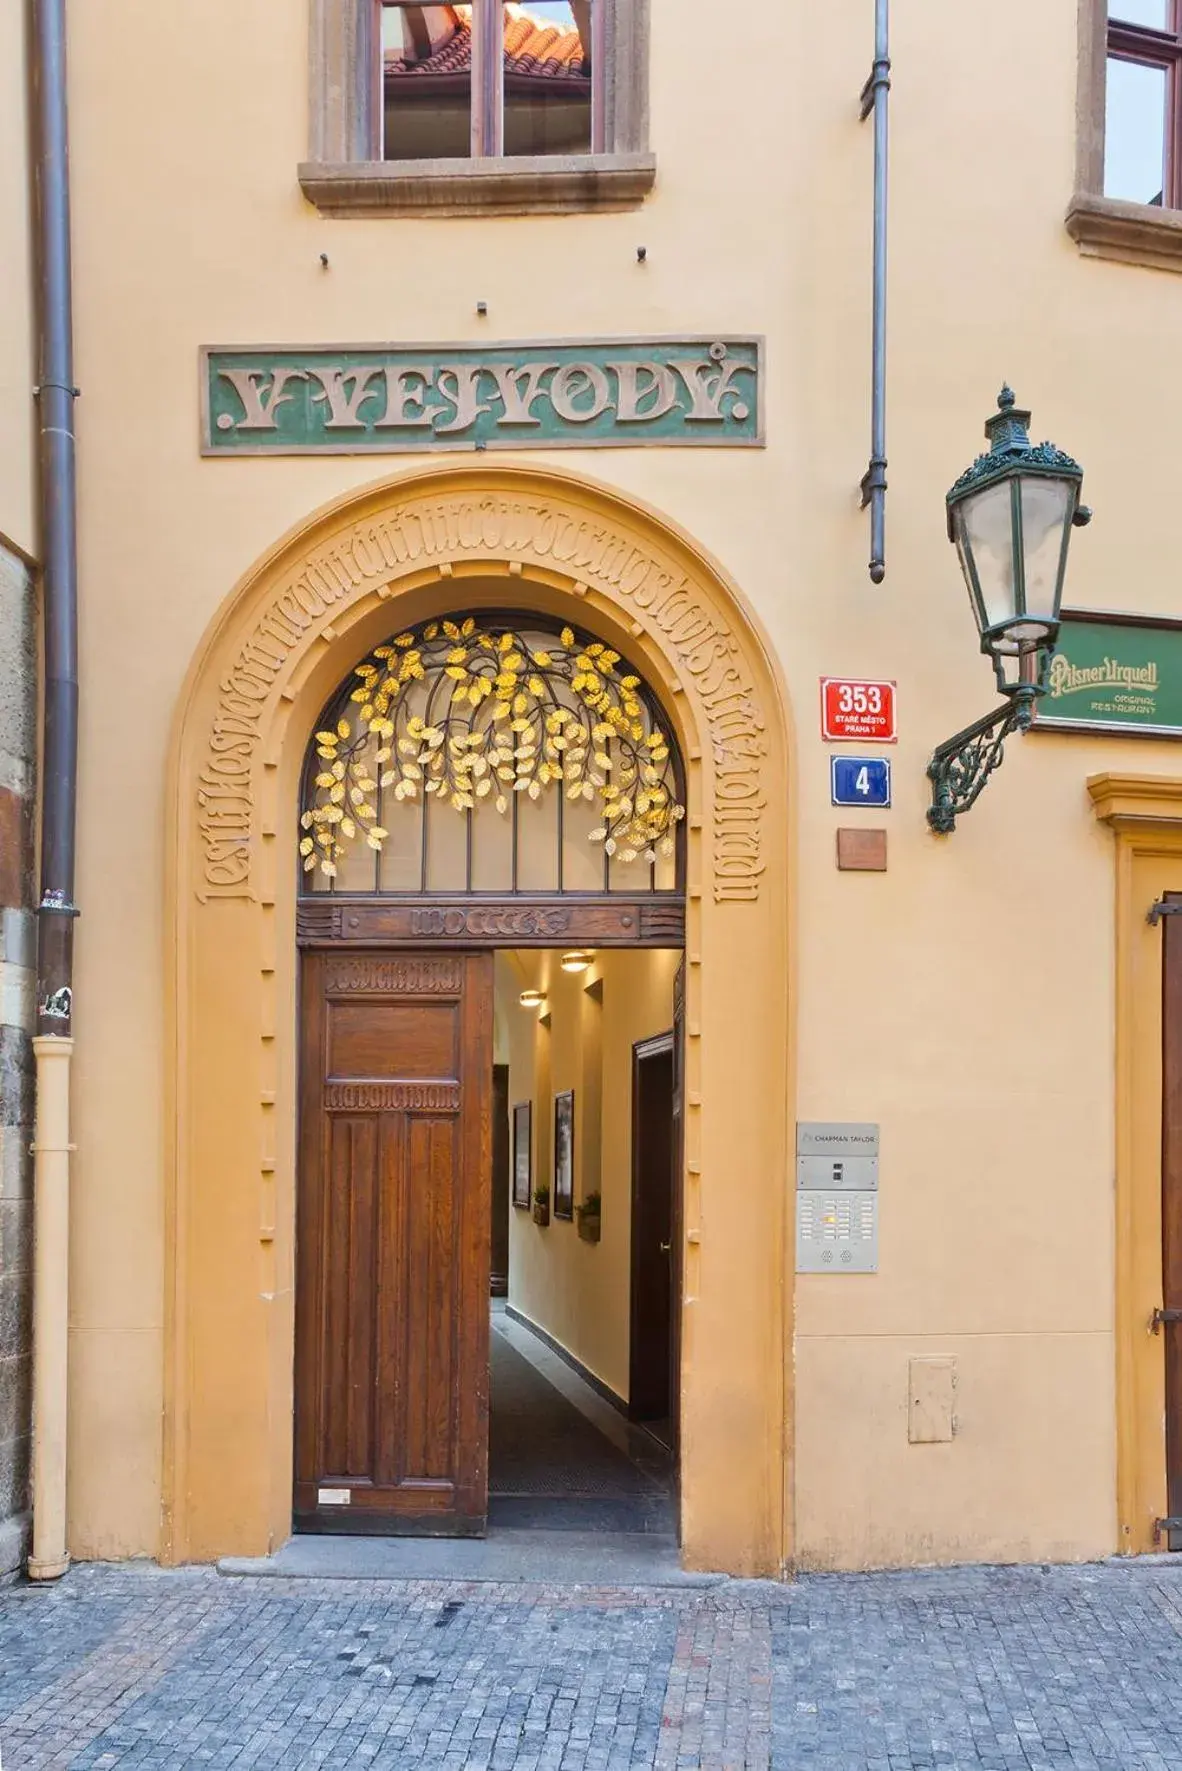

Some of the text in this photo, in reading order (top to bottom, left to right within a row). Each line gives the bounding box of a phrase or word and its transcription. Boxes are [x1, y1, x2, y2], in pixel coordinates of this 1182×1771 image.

[1050, 654, 1158, 698] Pilsner Urquell
[839, 685, 881, 713] 353
[835, 714, 859, 723] STARÉ
[845, 725, 870, 733] PRAHA
[856, 766, 869, 795] 4
